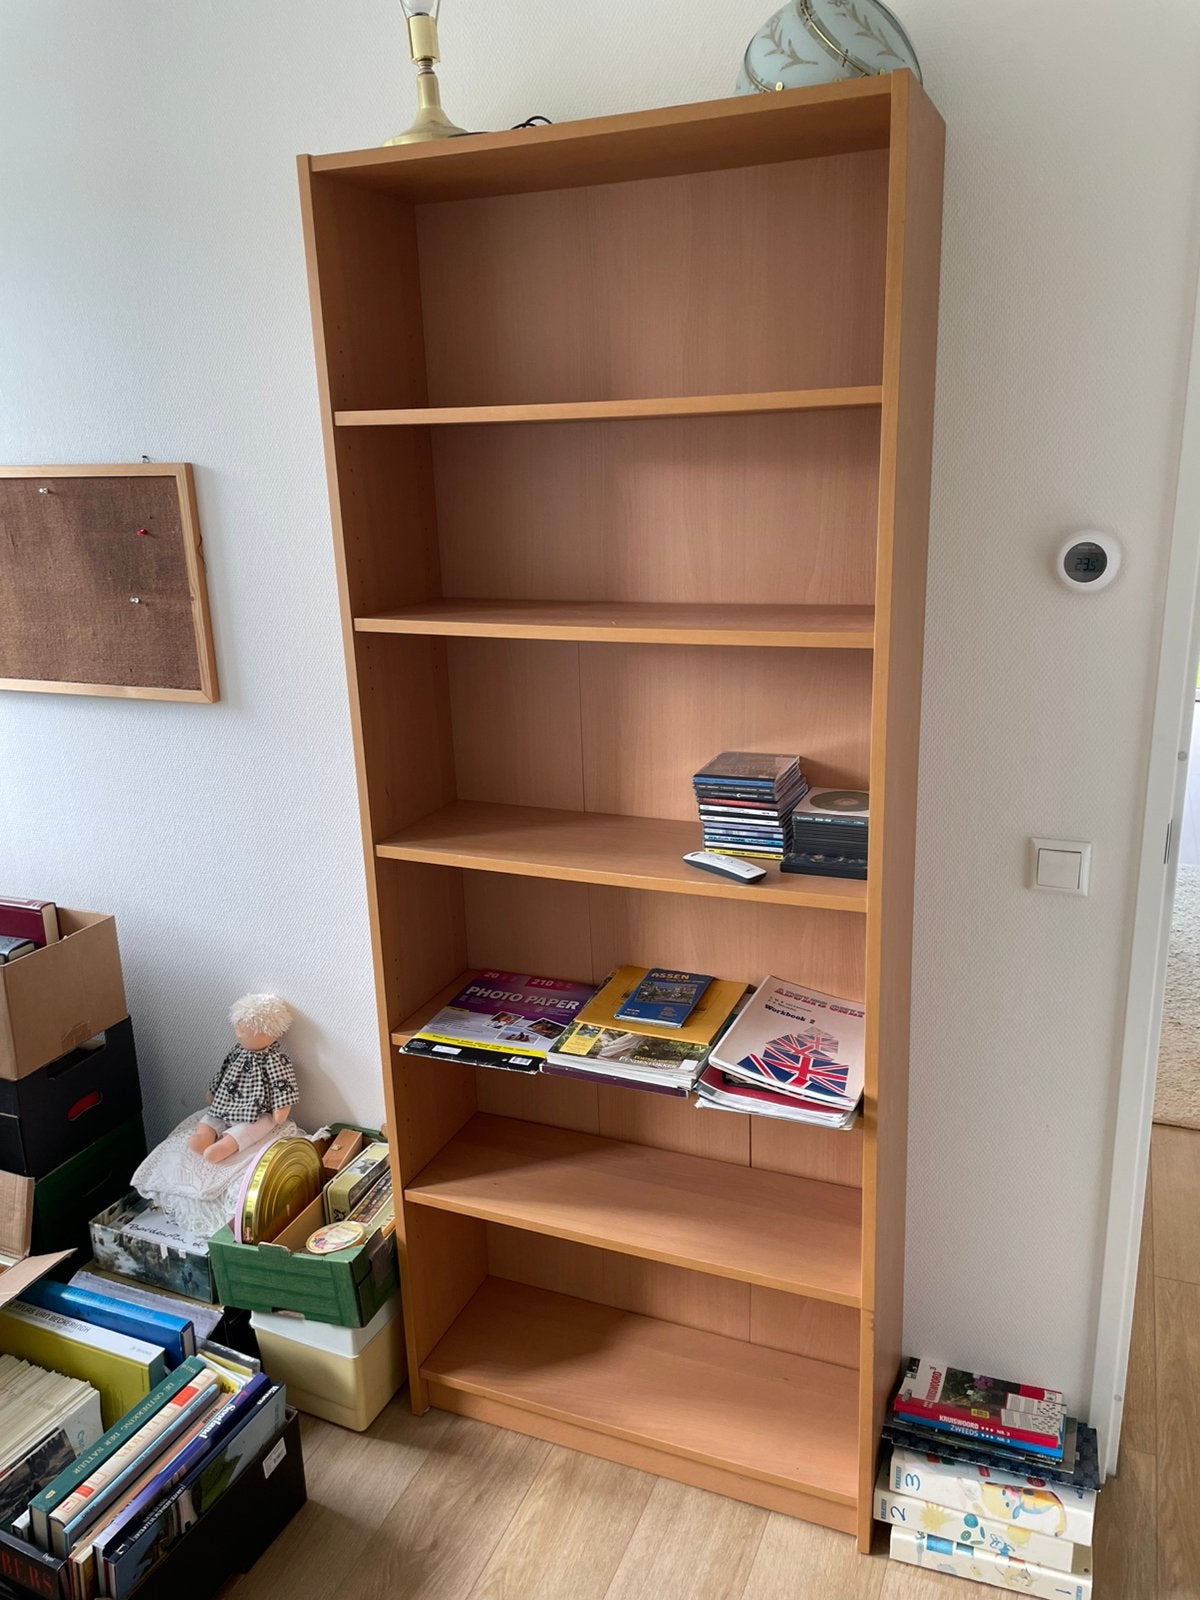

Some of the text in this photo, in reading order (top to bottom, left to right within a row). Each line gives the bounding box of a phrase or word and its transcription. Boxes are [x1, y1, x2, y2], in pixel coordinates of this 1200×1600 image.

[532, 978, 555, 988] 210
[650, 972, 690, 981] ASSEN
[466, 986, 524, 1003] PHOTO
[526, 995, 580, 1010] PAPER
[764, 1004, 806, 1023] Workbook
[16, 1302, 35, 1317] ATLAS
[35, 1307, 51, 1322] VAN
[162, 1382, 175, 1393] DE
[256, 1385, 280, 1406] Wenen
[120, 1390, 164, 1433] ONTDEKKING
[199, 1403, 237, 1440] Scotland
[939, 1414, 979, 1430] KRUISWOORD
[103, 1431, 120, 1448] DER
[950, 1425, 979, 1438] ZWEEDS
[73, 1446, 105, 1476] NATUUR
[905, 1473, 921, 1491] 3
[890, 1506, 906, 1521] 2
